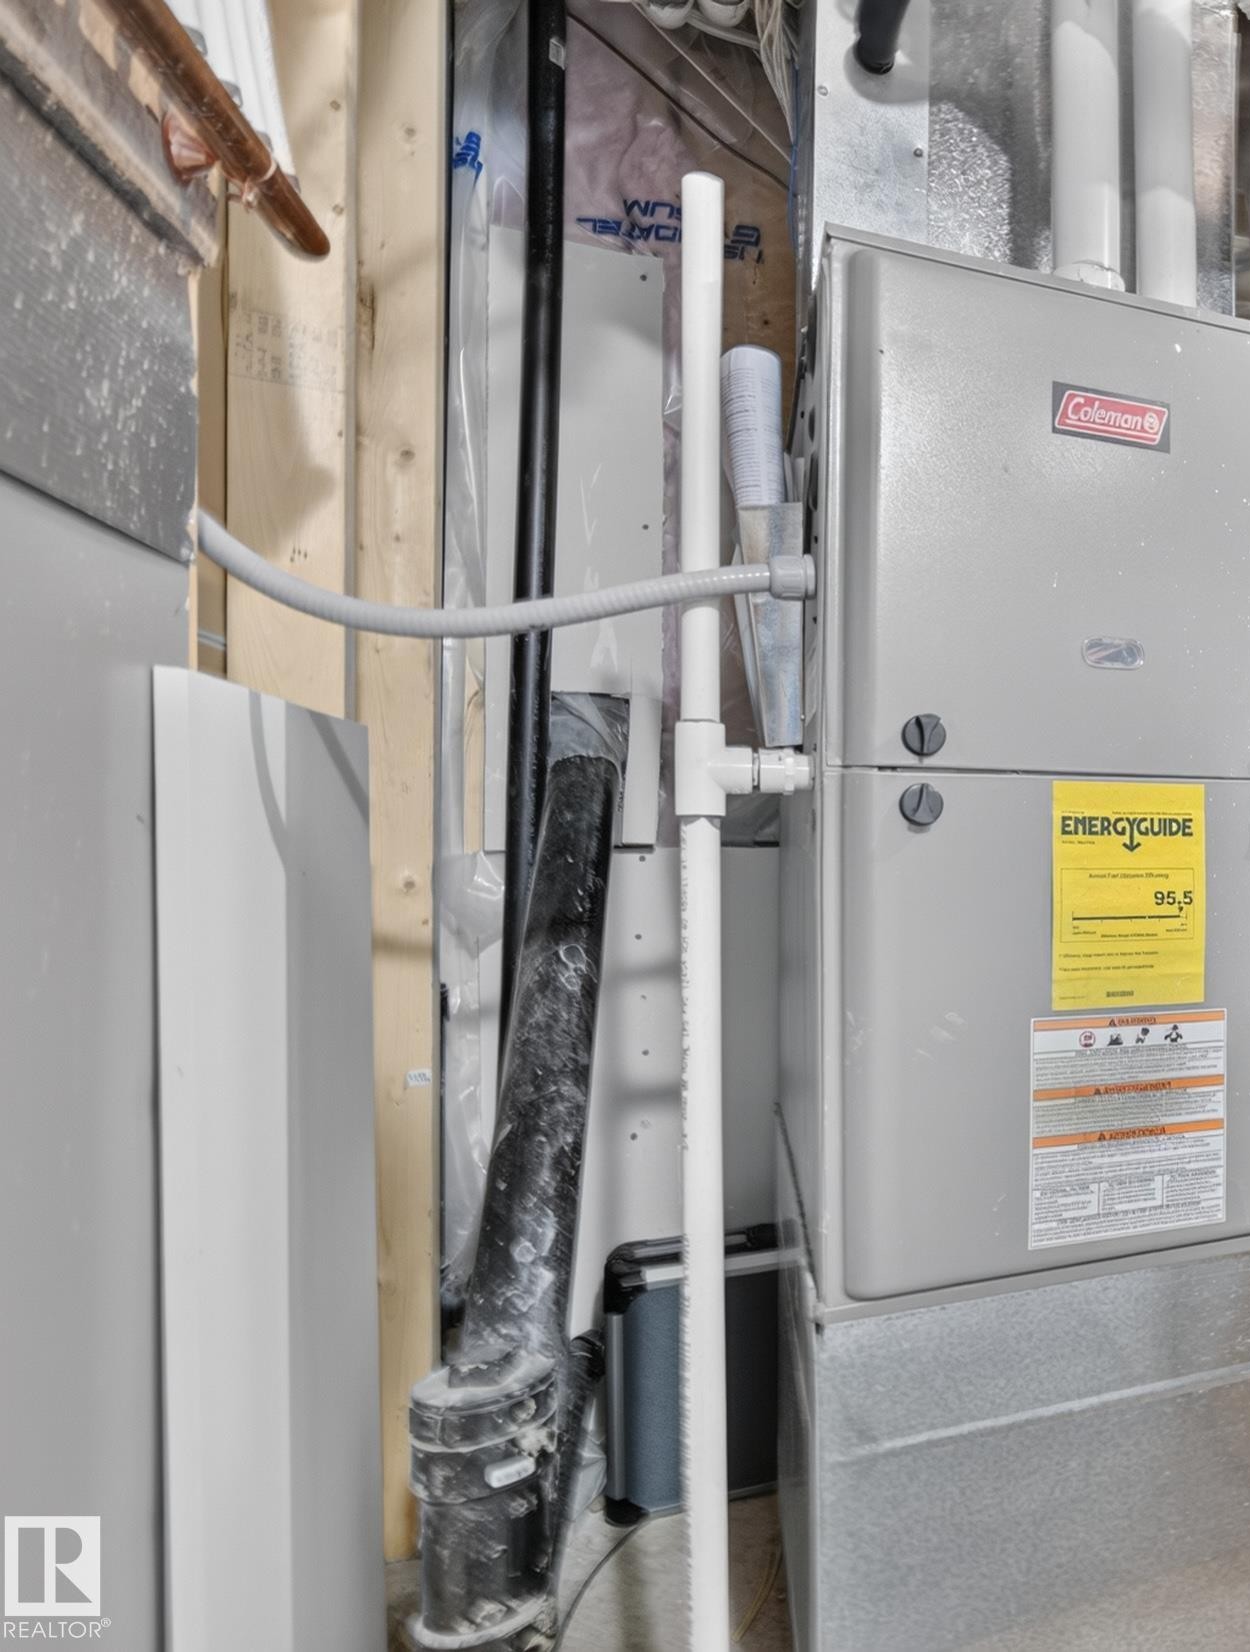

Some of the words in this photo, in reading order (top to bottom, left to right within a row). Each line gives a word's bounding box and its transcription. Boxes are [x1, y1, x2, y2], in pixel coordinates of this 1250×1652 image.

[1067, 397, 1142, 430] Coleman
[1061, 815, 1193, 838] ENERGYGUIDE
[1154, 890, 1193, 905] 95.5
